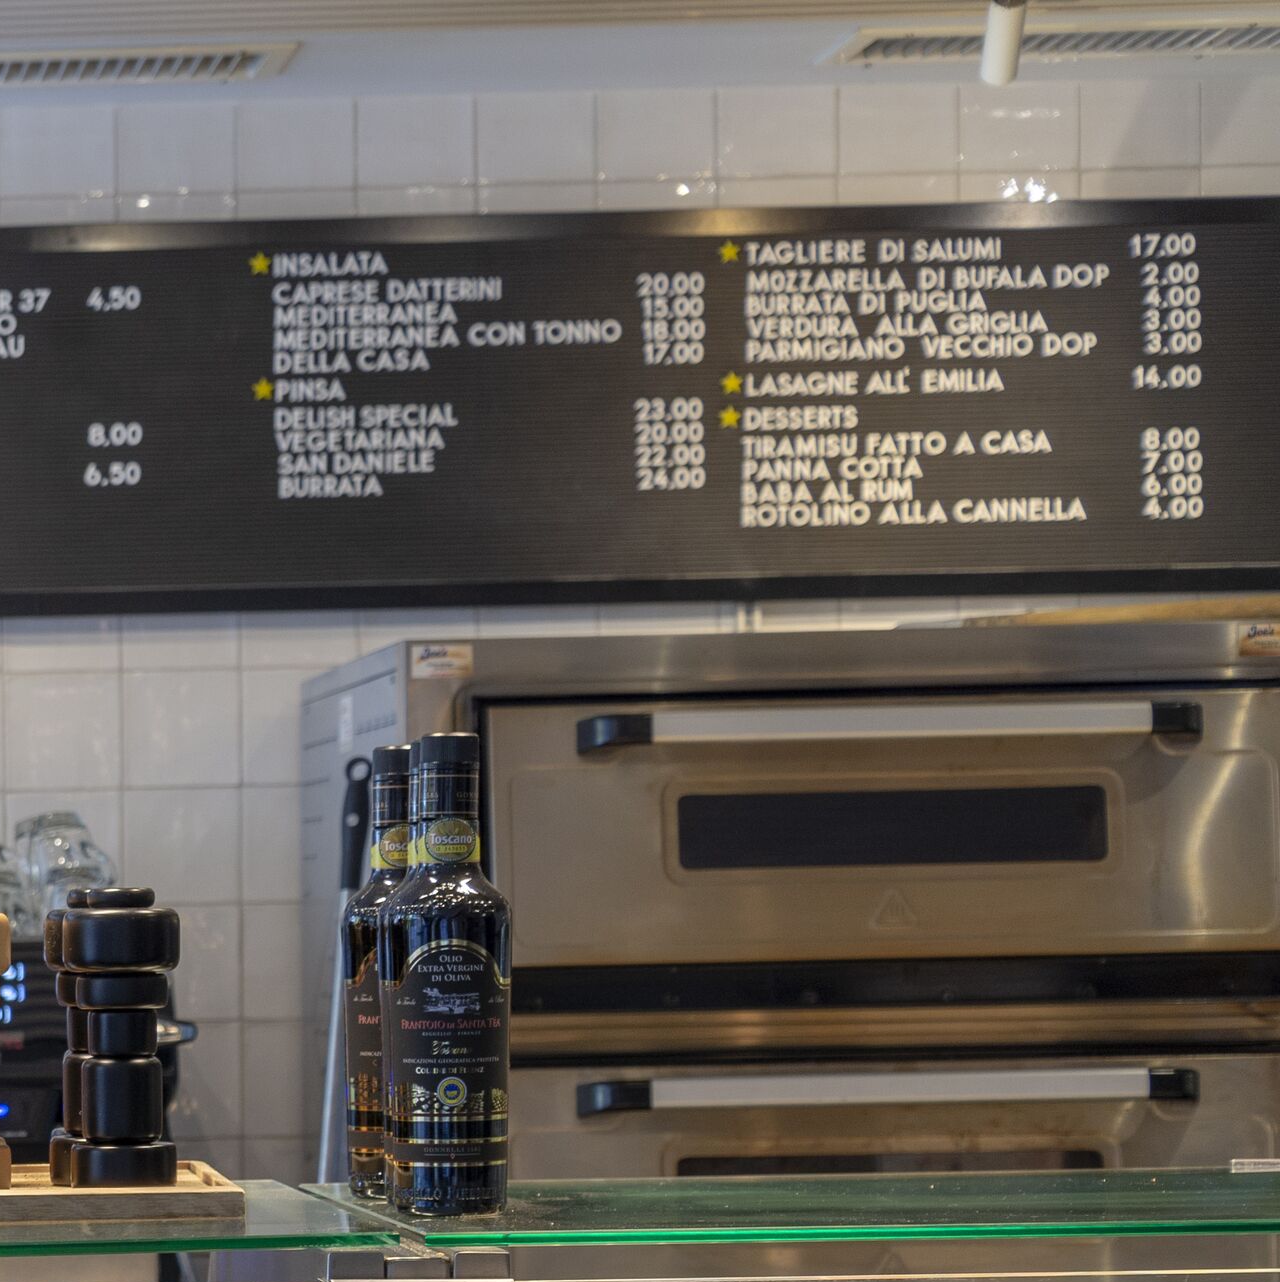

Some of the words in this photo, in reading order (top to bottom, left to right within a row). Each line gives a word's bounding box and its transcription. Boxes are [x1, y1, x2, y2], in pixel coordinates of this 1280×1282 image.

[745, 240, 865, 266] TAGLIERE
[877, 239, 905, 264] DI
[911, 237, 1002, 262] SALUMI
[1130, 232, 1196, 259] 17.00
[273, 252, 388, 278] INSALATA
[917, 266, 946, 291] DI
[952, 264, 1046, 290] BUFALA
[1053, 263, 1110, 289] DOP
[1141, 262, 1199, 286] 2.00
[272, 279, 378, 304] CAPRESE
[387, 276, 502, 301] DATTERINI
[745, 292, 851, 316] BURRATA
[859, 291, 886, 315] DI
[895, 289, 987, 314] PUGLIA
[1143, 286, 1201, 310] 4.00
[274, 301, 457, 328] MEDITERRANEA
[746, 314, 858, 340] VERDURA
[875, 313, 938, 337] ALLA
[946, 311, 1049, 335] GRIGLIA
[1141, 308, 1201, 332] 3.00
[274, 325, 459, 351] MEDITERRANEA
[468, 322, 525, 346] CON
[534, 319, 622, 345] TONNO
[745, 337, 905, 363] PARMIGIANO
[922, 335, 1034, 360] VECCHIO
[1041, 333, 1097, 358] DOP
[1144, 332, 1202, 356] 3.00
[273, 350, 351, 375] DELLA
[356, 349, 430, 372] CASA
[274, 378, 346, 403] PINSA
[745, 370, 858, 397] LASAGNE
[921, 368, 1005, 393] EMILIA
[1132, 364, 1202, 390] 14.00
[274, 405, 355, 431] DELISH
[360, 403, 458, 428] SPECIAL
[743, 405, 859, 431] DESSERTS
[276, 429, 445, 453] VEGETARIANA
[742, 434, 858, 460] TIRAMISU
[865, 431, 946, 456] FATTO
[952, 431, 976, 455] A
[981, 430, 1052, 455] CASA
[1141, 427, 1200, 451] 8.00
[278, 451, 328, 475] SAN
[333, 450, 435, 474] DANIELE
[743, 459, 831, 481] PANNA
[840, 456, 923, 480] COTTA
[1141, 451, 1203, 474] 7.00
[278, 474, 383, 499] BURRATA
[743, 481, 814, 502] BABA
[821, 480, 853, 502] AL
[860, 479, 913, 501] RUM
[1141, 473, 1203, 497] 6.00
[742, 502, 871, 528] ROTOLINO
[878, 500, 947, 525] ALLA
[952, 497, 1087, 524] CANNELLA
[1143, 497, 1205, 521] 4.00
[430, 833, 472, 844] Toscano
[417, 964, 444, 973] EXTRA
[447, 964, 484, 972] VERGINE
